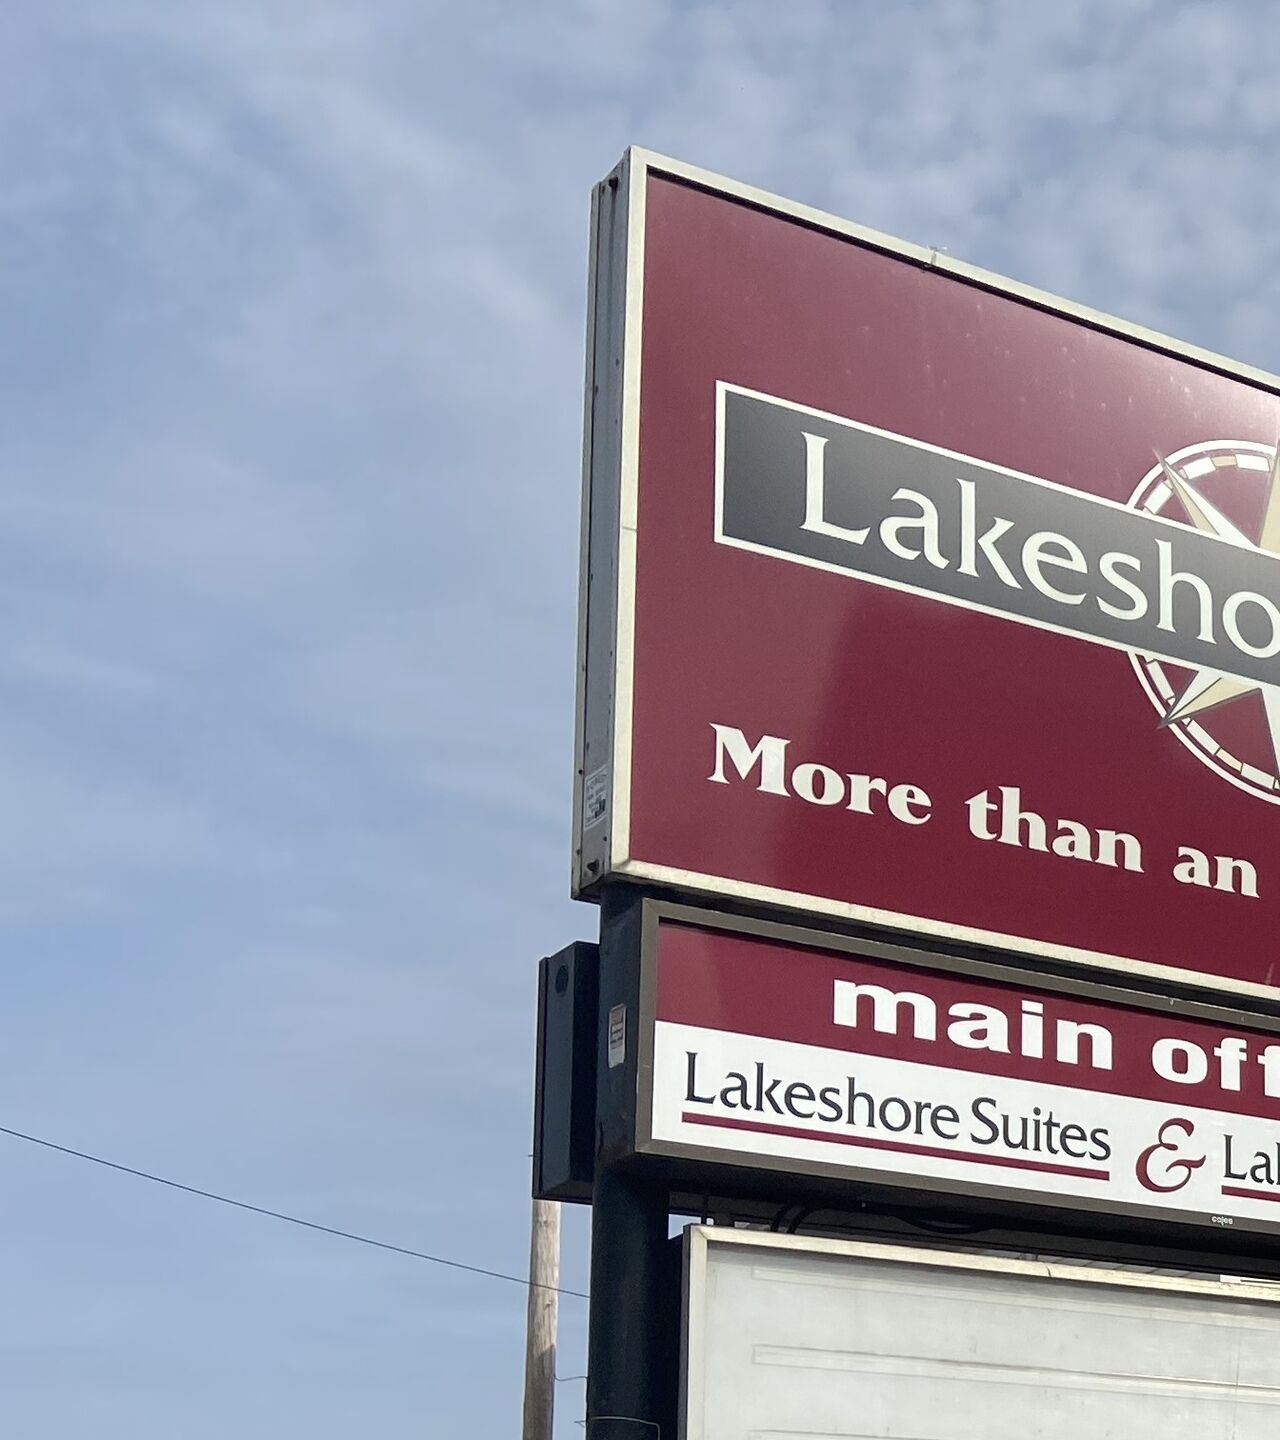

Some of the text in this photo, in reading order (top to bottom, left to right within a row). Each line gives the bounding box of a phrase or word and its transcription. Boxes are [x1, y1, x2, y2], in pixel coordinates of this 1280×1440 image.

[706, 722, 932, 827] More
[963, 784, 1145, 873] than
[1172, 846, 1260, 900] an
[833, 978, 1114, 1072] main
[683, 1050, 960, 1141] Lakeshore
[969, 1096, 1112, 1162] Suites
[1134, 1117, 1207, 1194] &
